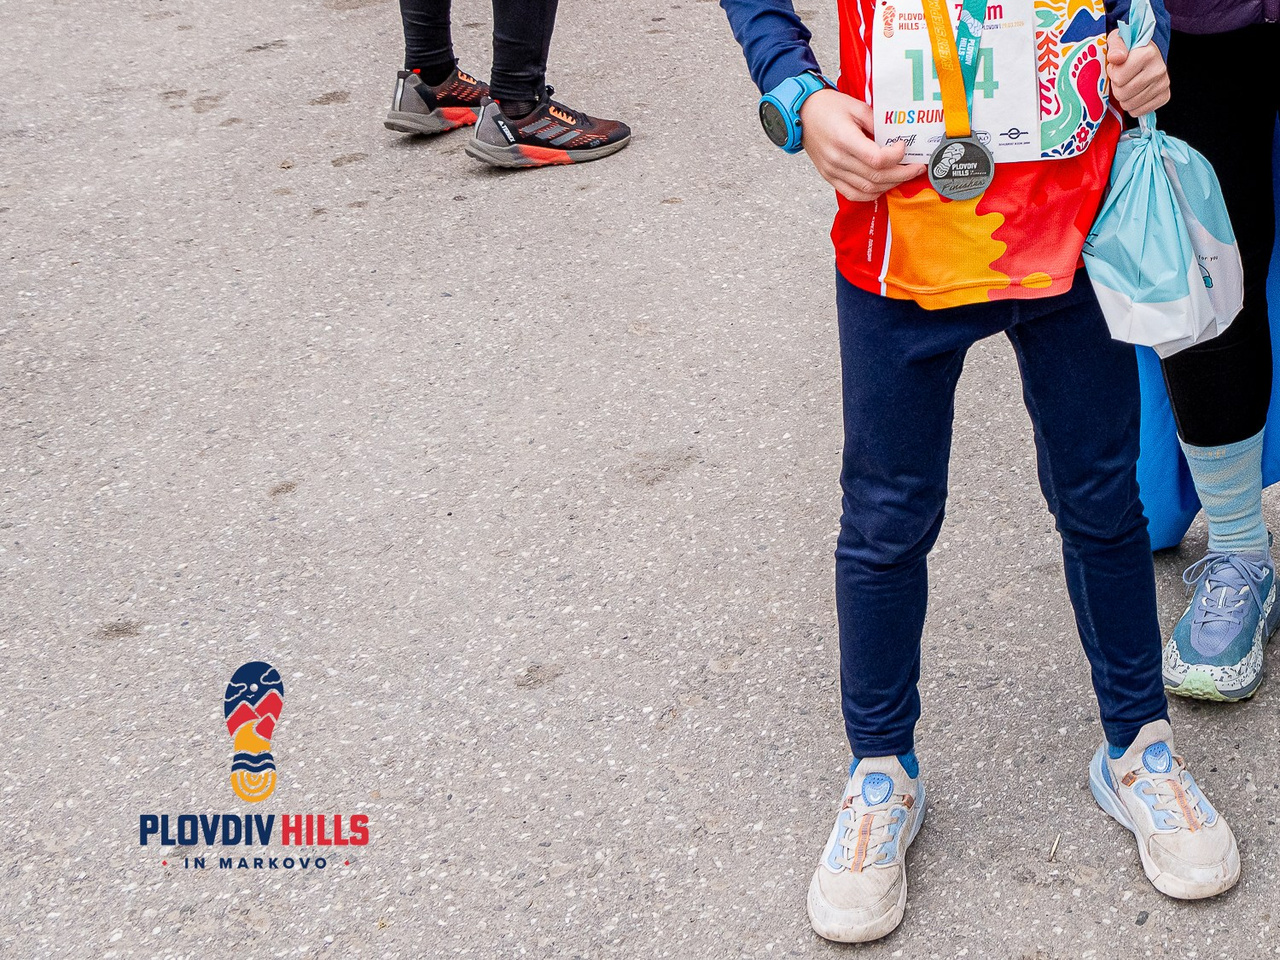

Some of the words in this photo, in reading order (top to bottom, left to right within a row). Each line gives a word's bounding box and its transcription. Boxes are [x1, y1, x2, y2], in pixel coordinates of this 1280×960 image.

[958, 37, 968, 57] HILLS
[965, 38, 976, 66] PLOVDIV
[885, 110, 915, 125] KIDS
[916, 110, 944, 124] RUN
